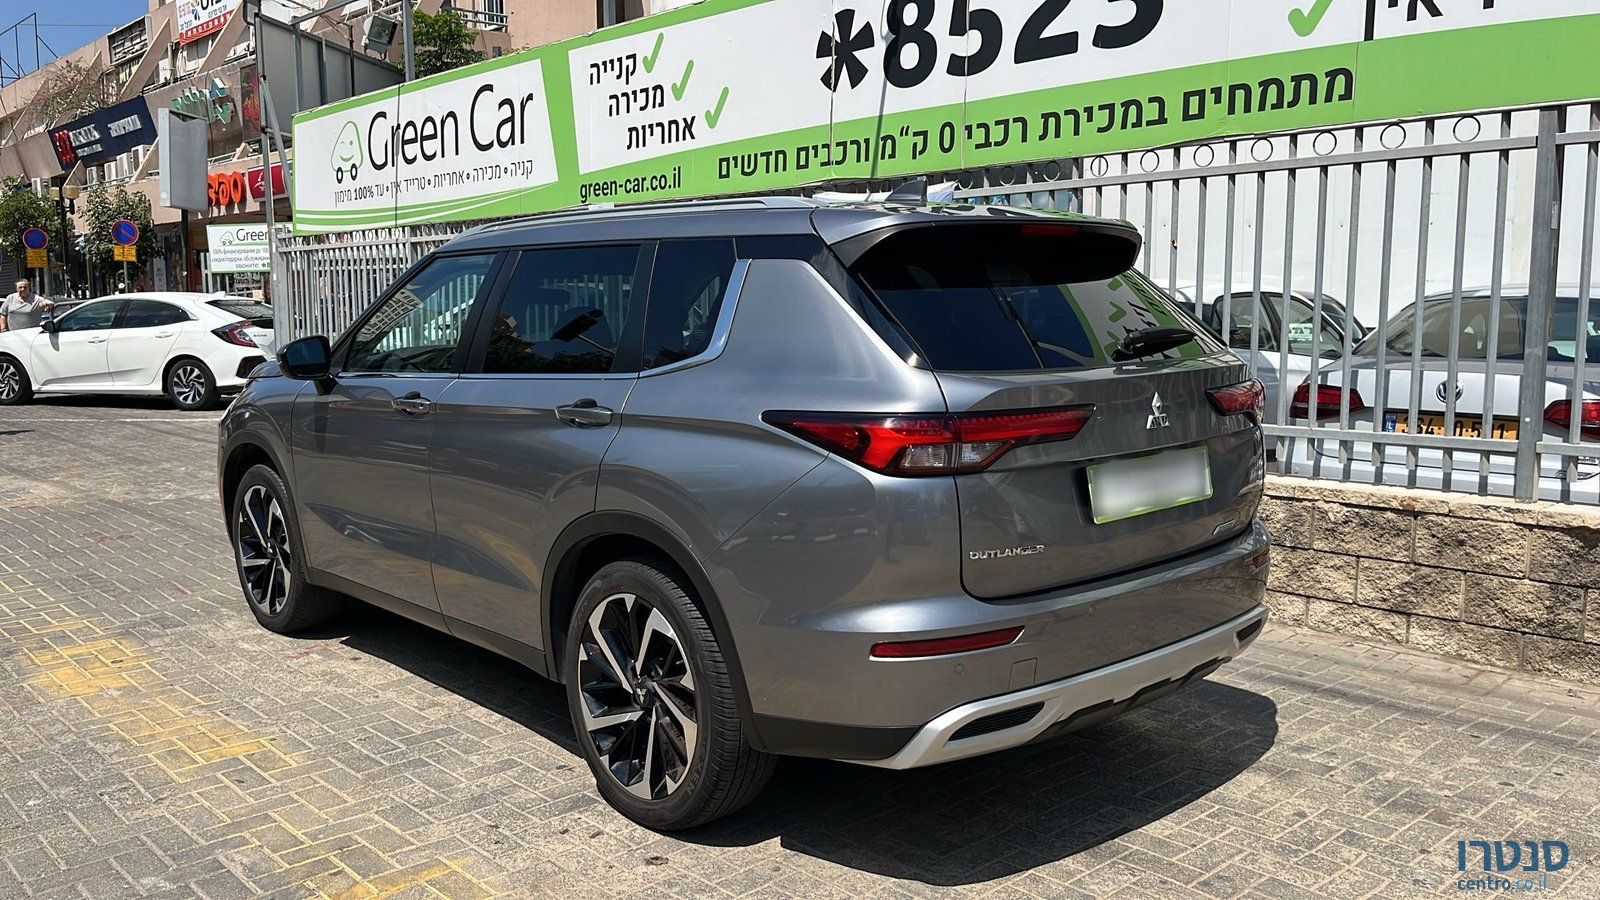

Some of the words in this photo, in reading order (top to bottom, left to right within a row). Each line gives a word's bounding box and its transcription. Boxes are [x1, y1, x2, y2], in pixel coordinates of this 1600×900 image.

[589, 53, 637, 86] קנייה
[608, 84, 665, 117] מכירה
[1182, 67, 1354, 122] מתמחים
[367, 111, 459, 171] Green
[470, 83, 534, 152] Car
[626, 116, 696, 150] אחריות
[965, 116, 1028, 150] רכבי
[1039, 96, 1168, 142] במכירת
[510, 159, 534, 180] קניה
[718, 149, 787, 180] חדשים
[796, 137, 870, 171] ורכבים
[433, 170, 464, 189] אחריות
[473, 164, 501, 182] מכירה
[580, 166, 681, 203] green-car.co.il
[354, 185, 375, 201] 100%
[969, 544, 1045, 560] OUTLANDER
